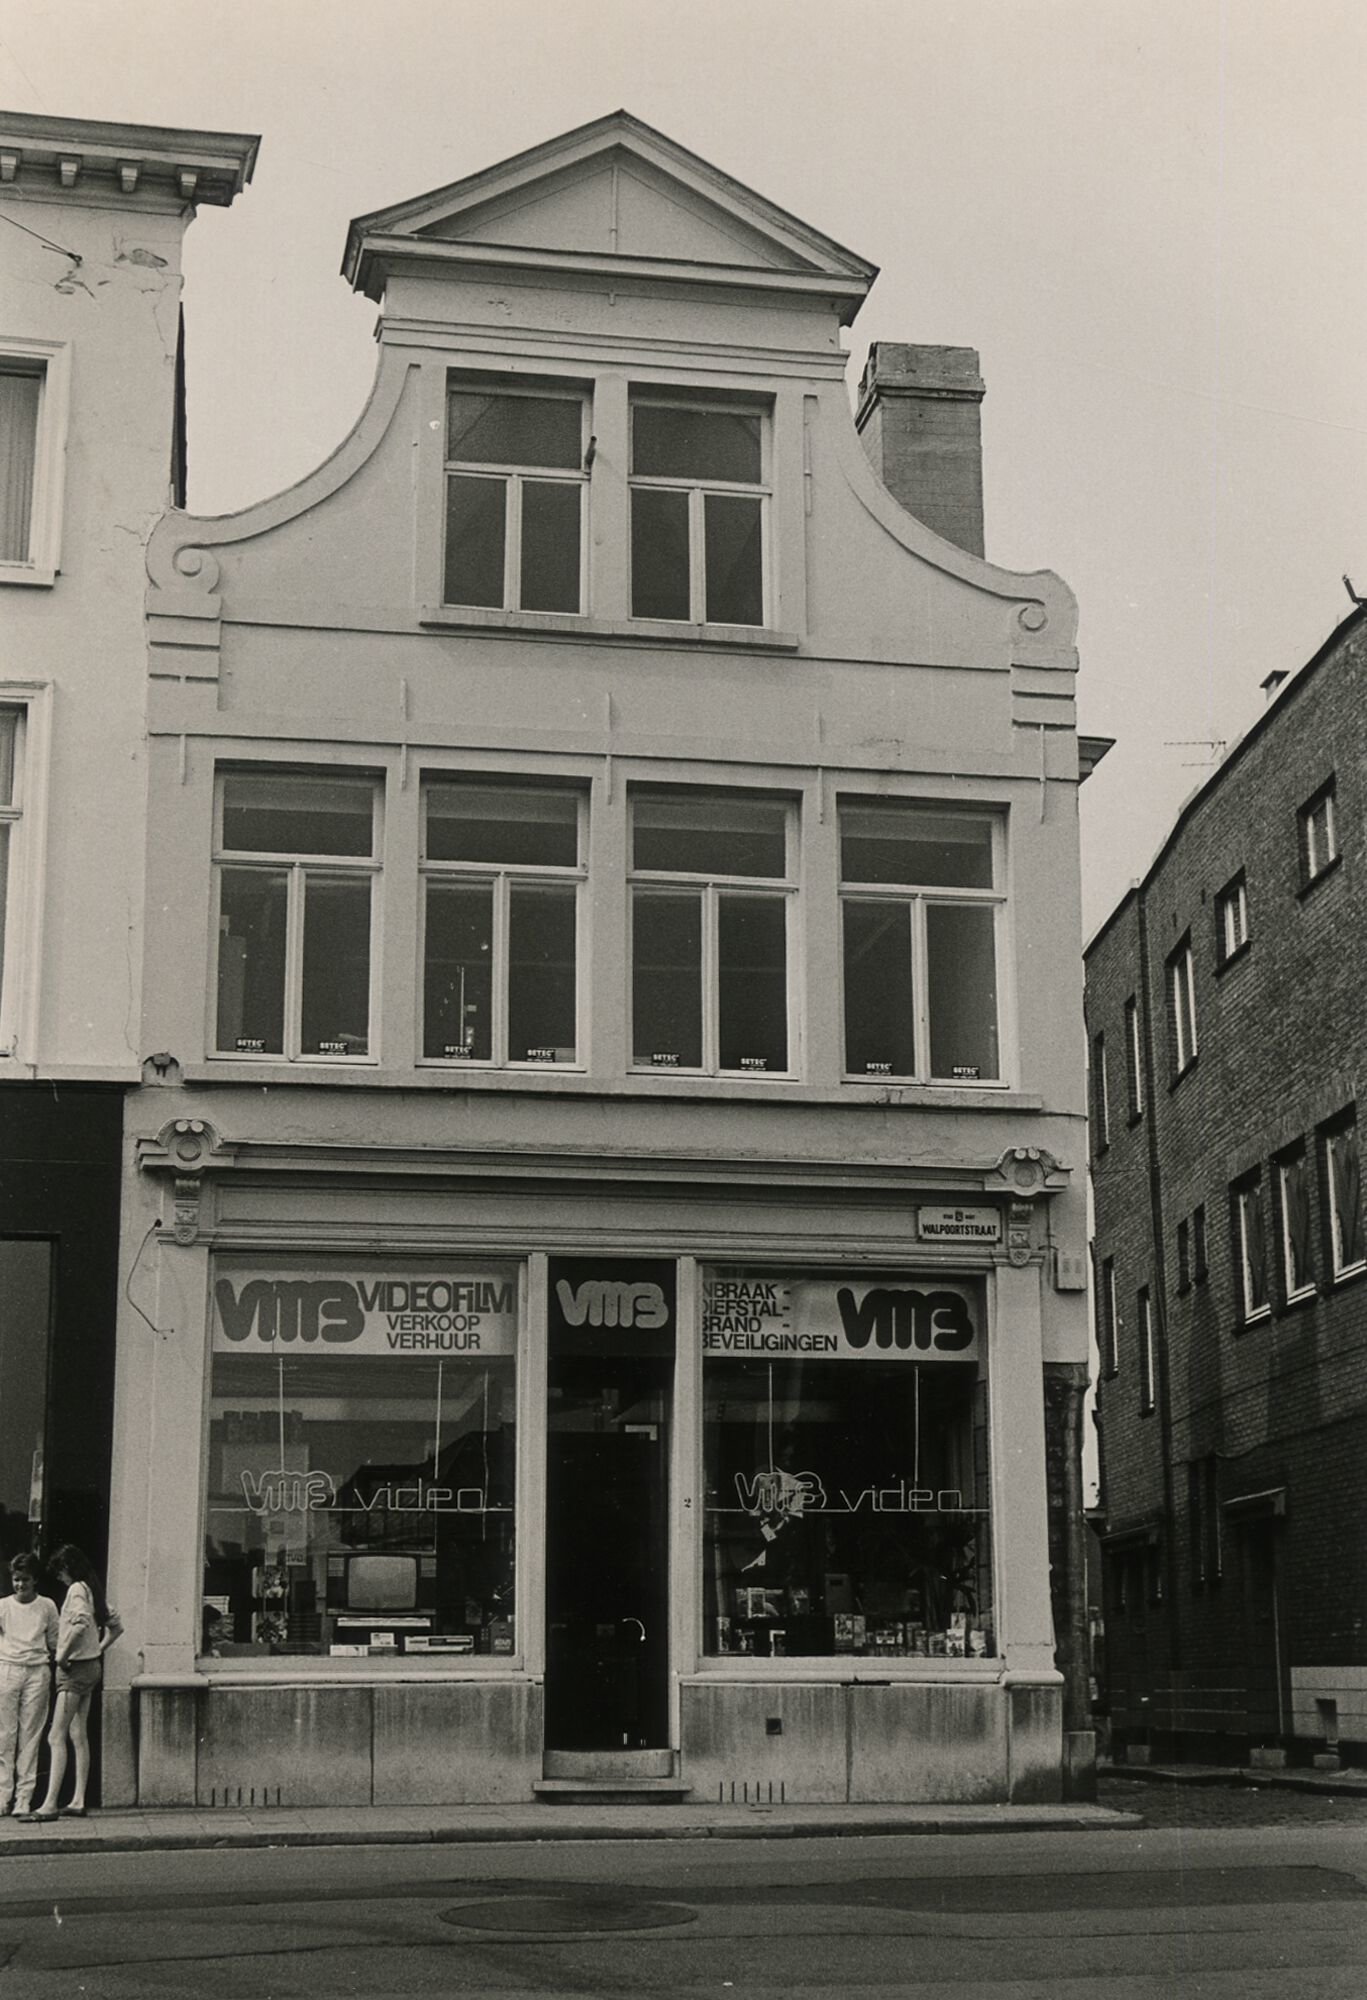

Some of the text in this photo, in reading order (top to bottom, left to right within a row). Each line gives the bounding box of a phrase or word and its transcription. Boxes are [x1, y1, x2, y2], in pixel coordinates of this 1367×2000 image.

[922, 1224, 997, 1236] WALPOORTSTRAAT
[386, 1314, 481, 1332] VERKOOP
[386, 1332, 481, 1350] VERHUUR
[353, 1477, 484, 1512] video
[840, 1479, 962, 1513] video
